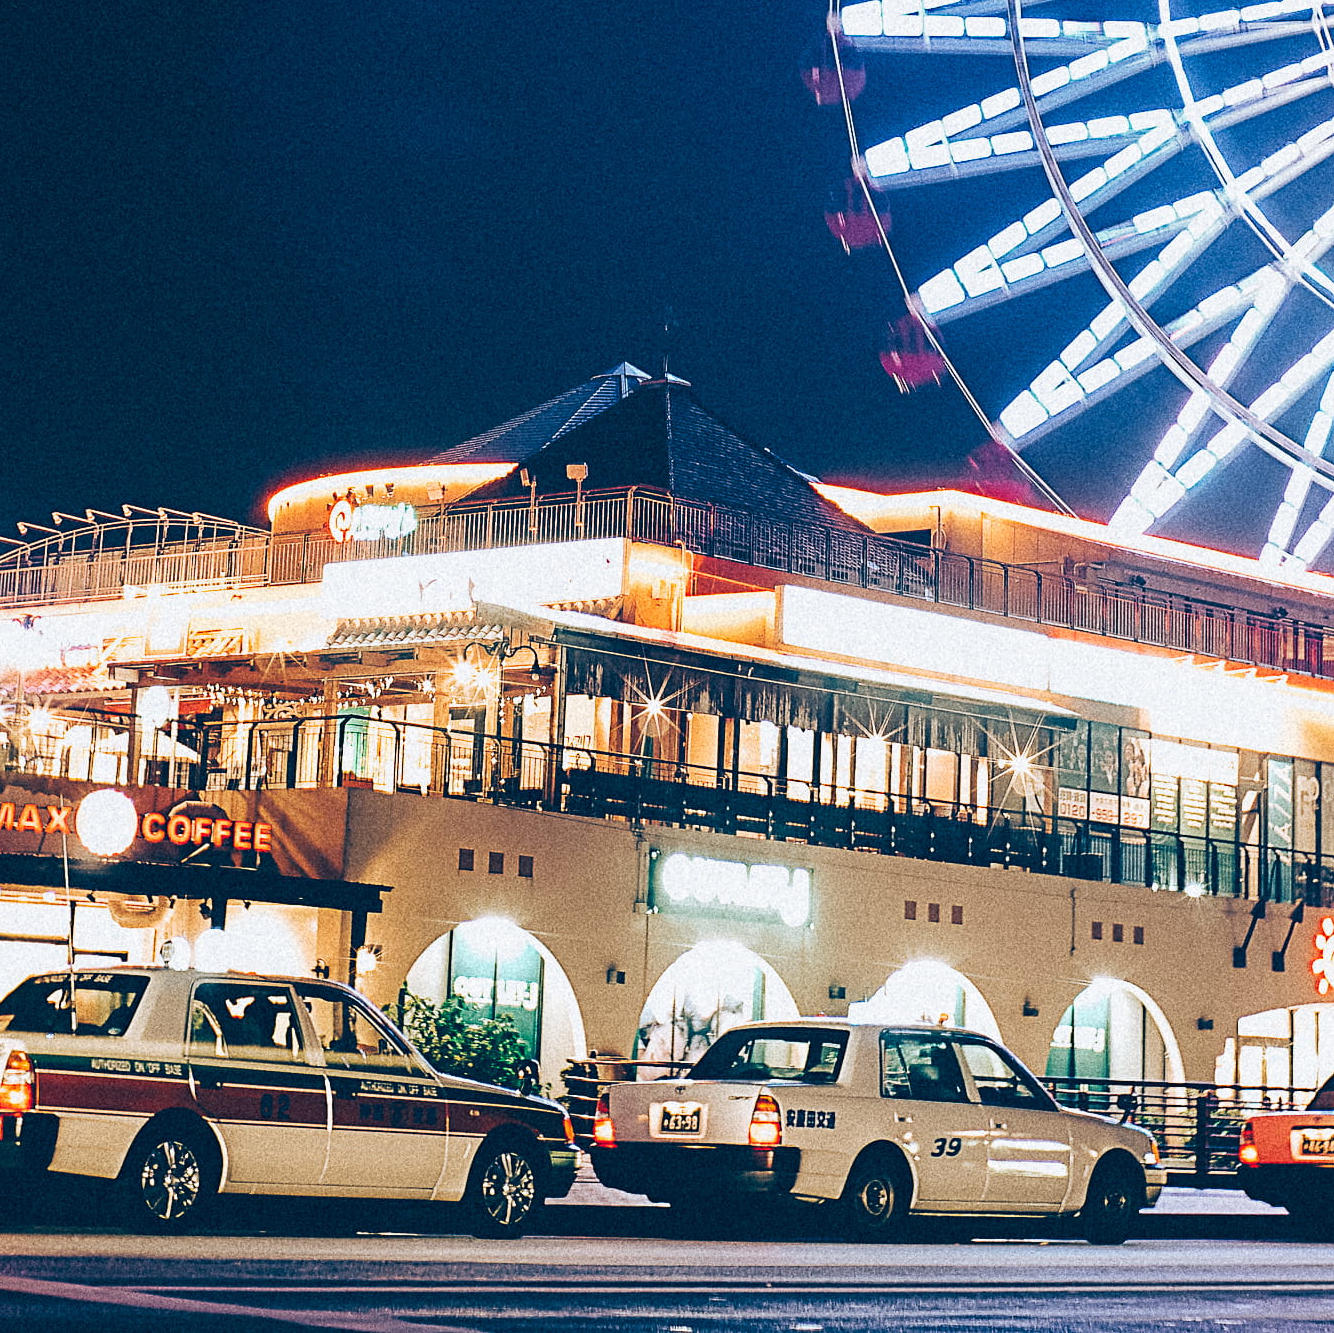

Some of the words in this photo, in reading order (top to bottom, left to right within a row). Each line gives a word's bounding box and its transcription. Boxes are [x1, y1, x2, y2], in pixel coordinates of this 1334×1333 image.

[1059, 802, 1085, 818] 0120
[142, 813, 272, 851] COFFEE
[930, 1137, 962, 1158] 39
